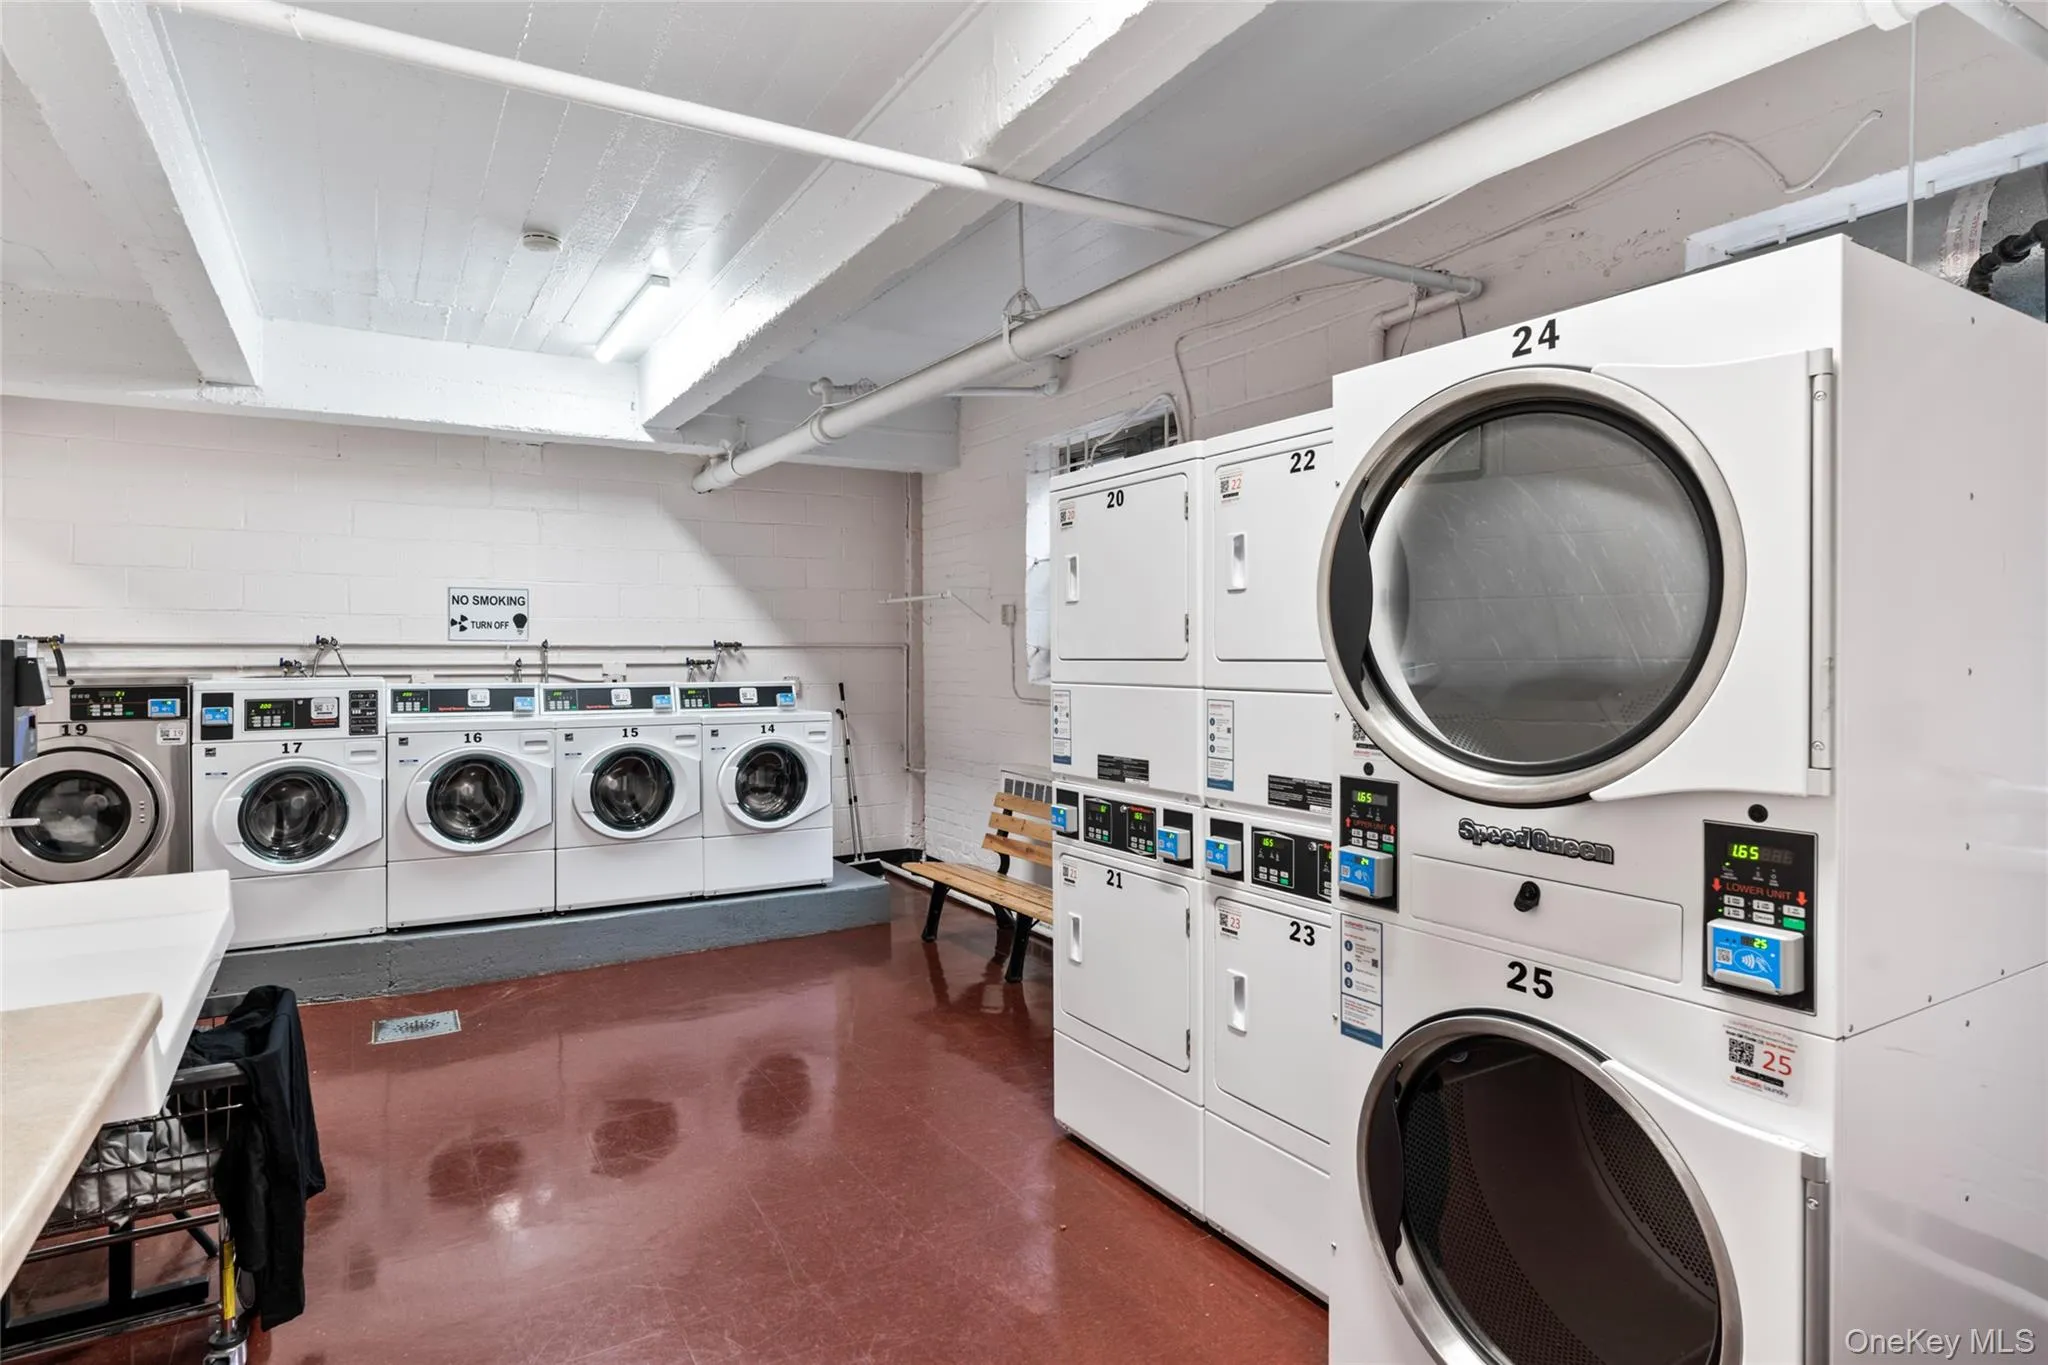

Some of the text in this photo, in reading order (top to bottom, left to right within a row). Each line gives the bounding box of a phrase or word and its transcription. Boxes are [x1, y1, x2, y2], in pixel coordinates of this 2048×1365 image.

[1512, 319, 1560, 358] 24
[1290, 450, 1315, 474] 22
[1107, 490, 1124, 508] 20
[451, 595, 526, 606] NO SMOKING
[471, 621, 509, 629] TURN OFF
[61, 724, 88, 736] 19
[622, 728, 638, 737] 15
[761, 724, 775, 733] 14
[464, 733, 482, 743] 16
[282, 742, 302, 754] 17
[1106, 869, 1123, 889] 21
[1726, 882, 1764, 896] LOWER
[1766, 889, 1792, 900] UNIT
[1230, 917, 1240, 929] 23
[1289, 920, 1315, 946] 23
[1753, 938, 1768, 949] 25
[1506, 961, 1554, 999] 25
[1763, 1050, 1792, 1076] 25
